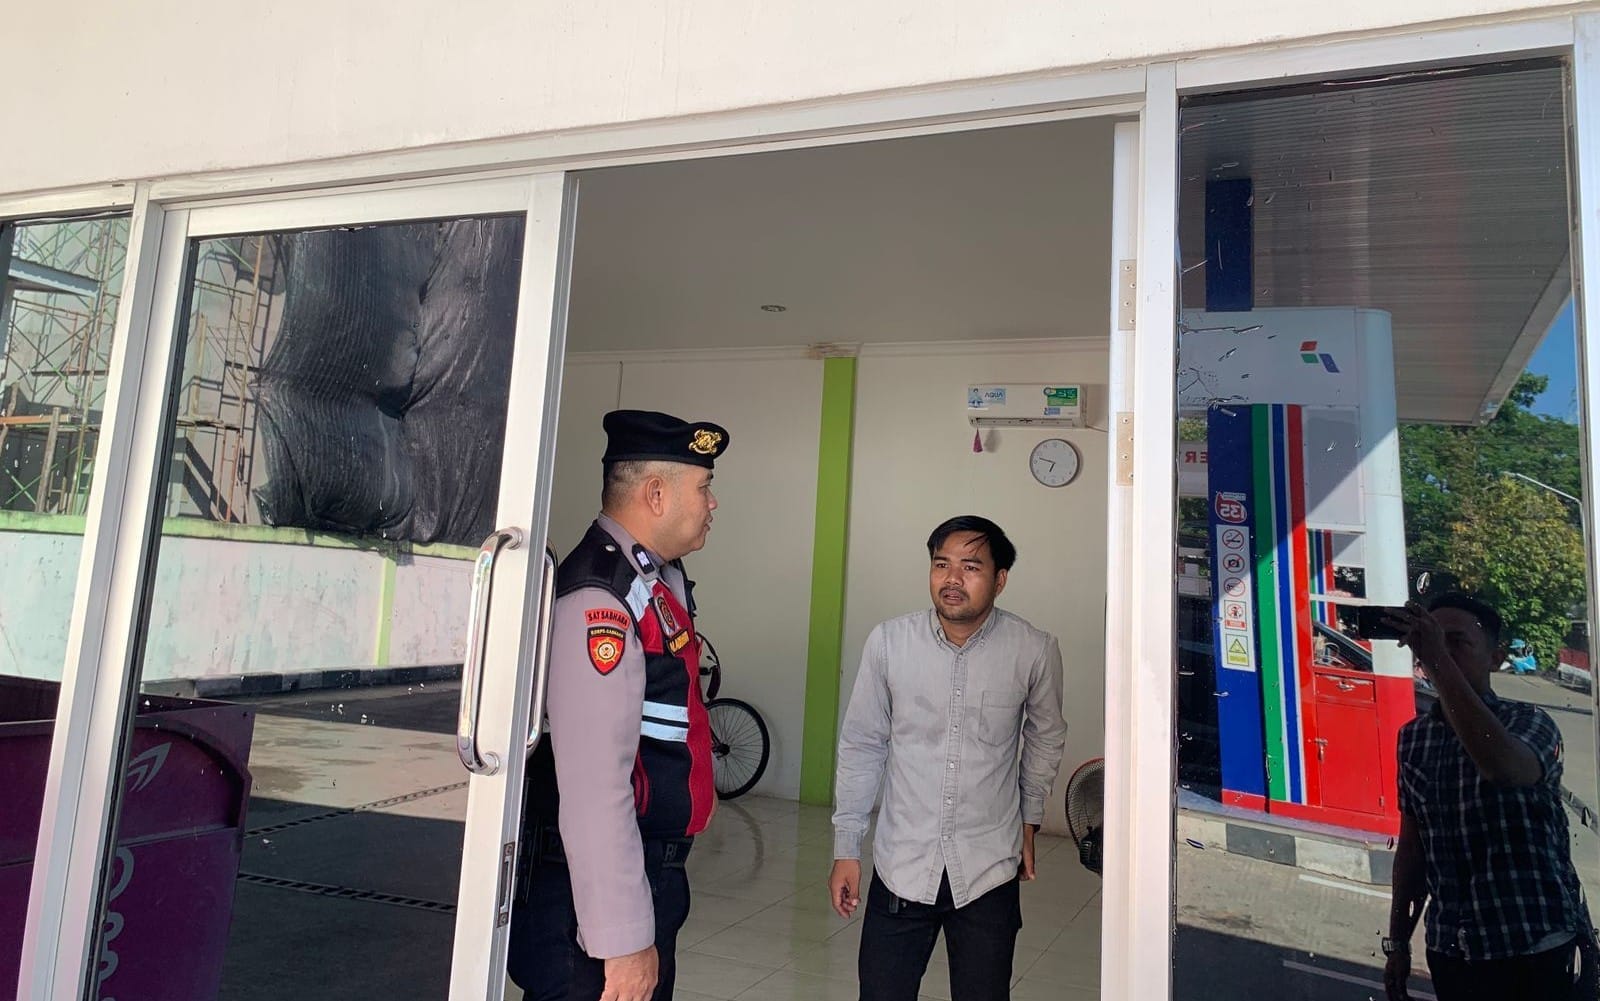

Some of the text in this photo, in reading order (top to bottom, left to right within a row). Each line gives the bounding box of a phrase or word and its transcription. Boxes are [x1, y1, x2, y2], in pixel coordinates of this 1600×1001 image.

[984, 391, 1004, 399] AQUA
[588, 611, 628, 626] SAT SABHARA
